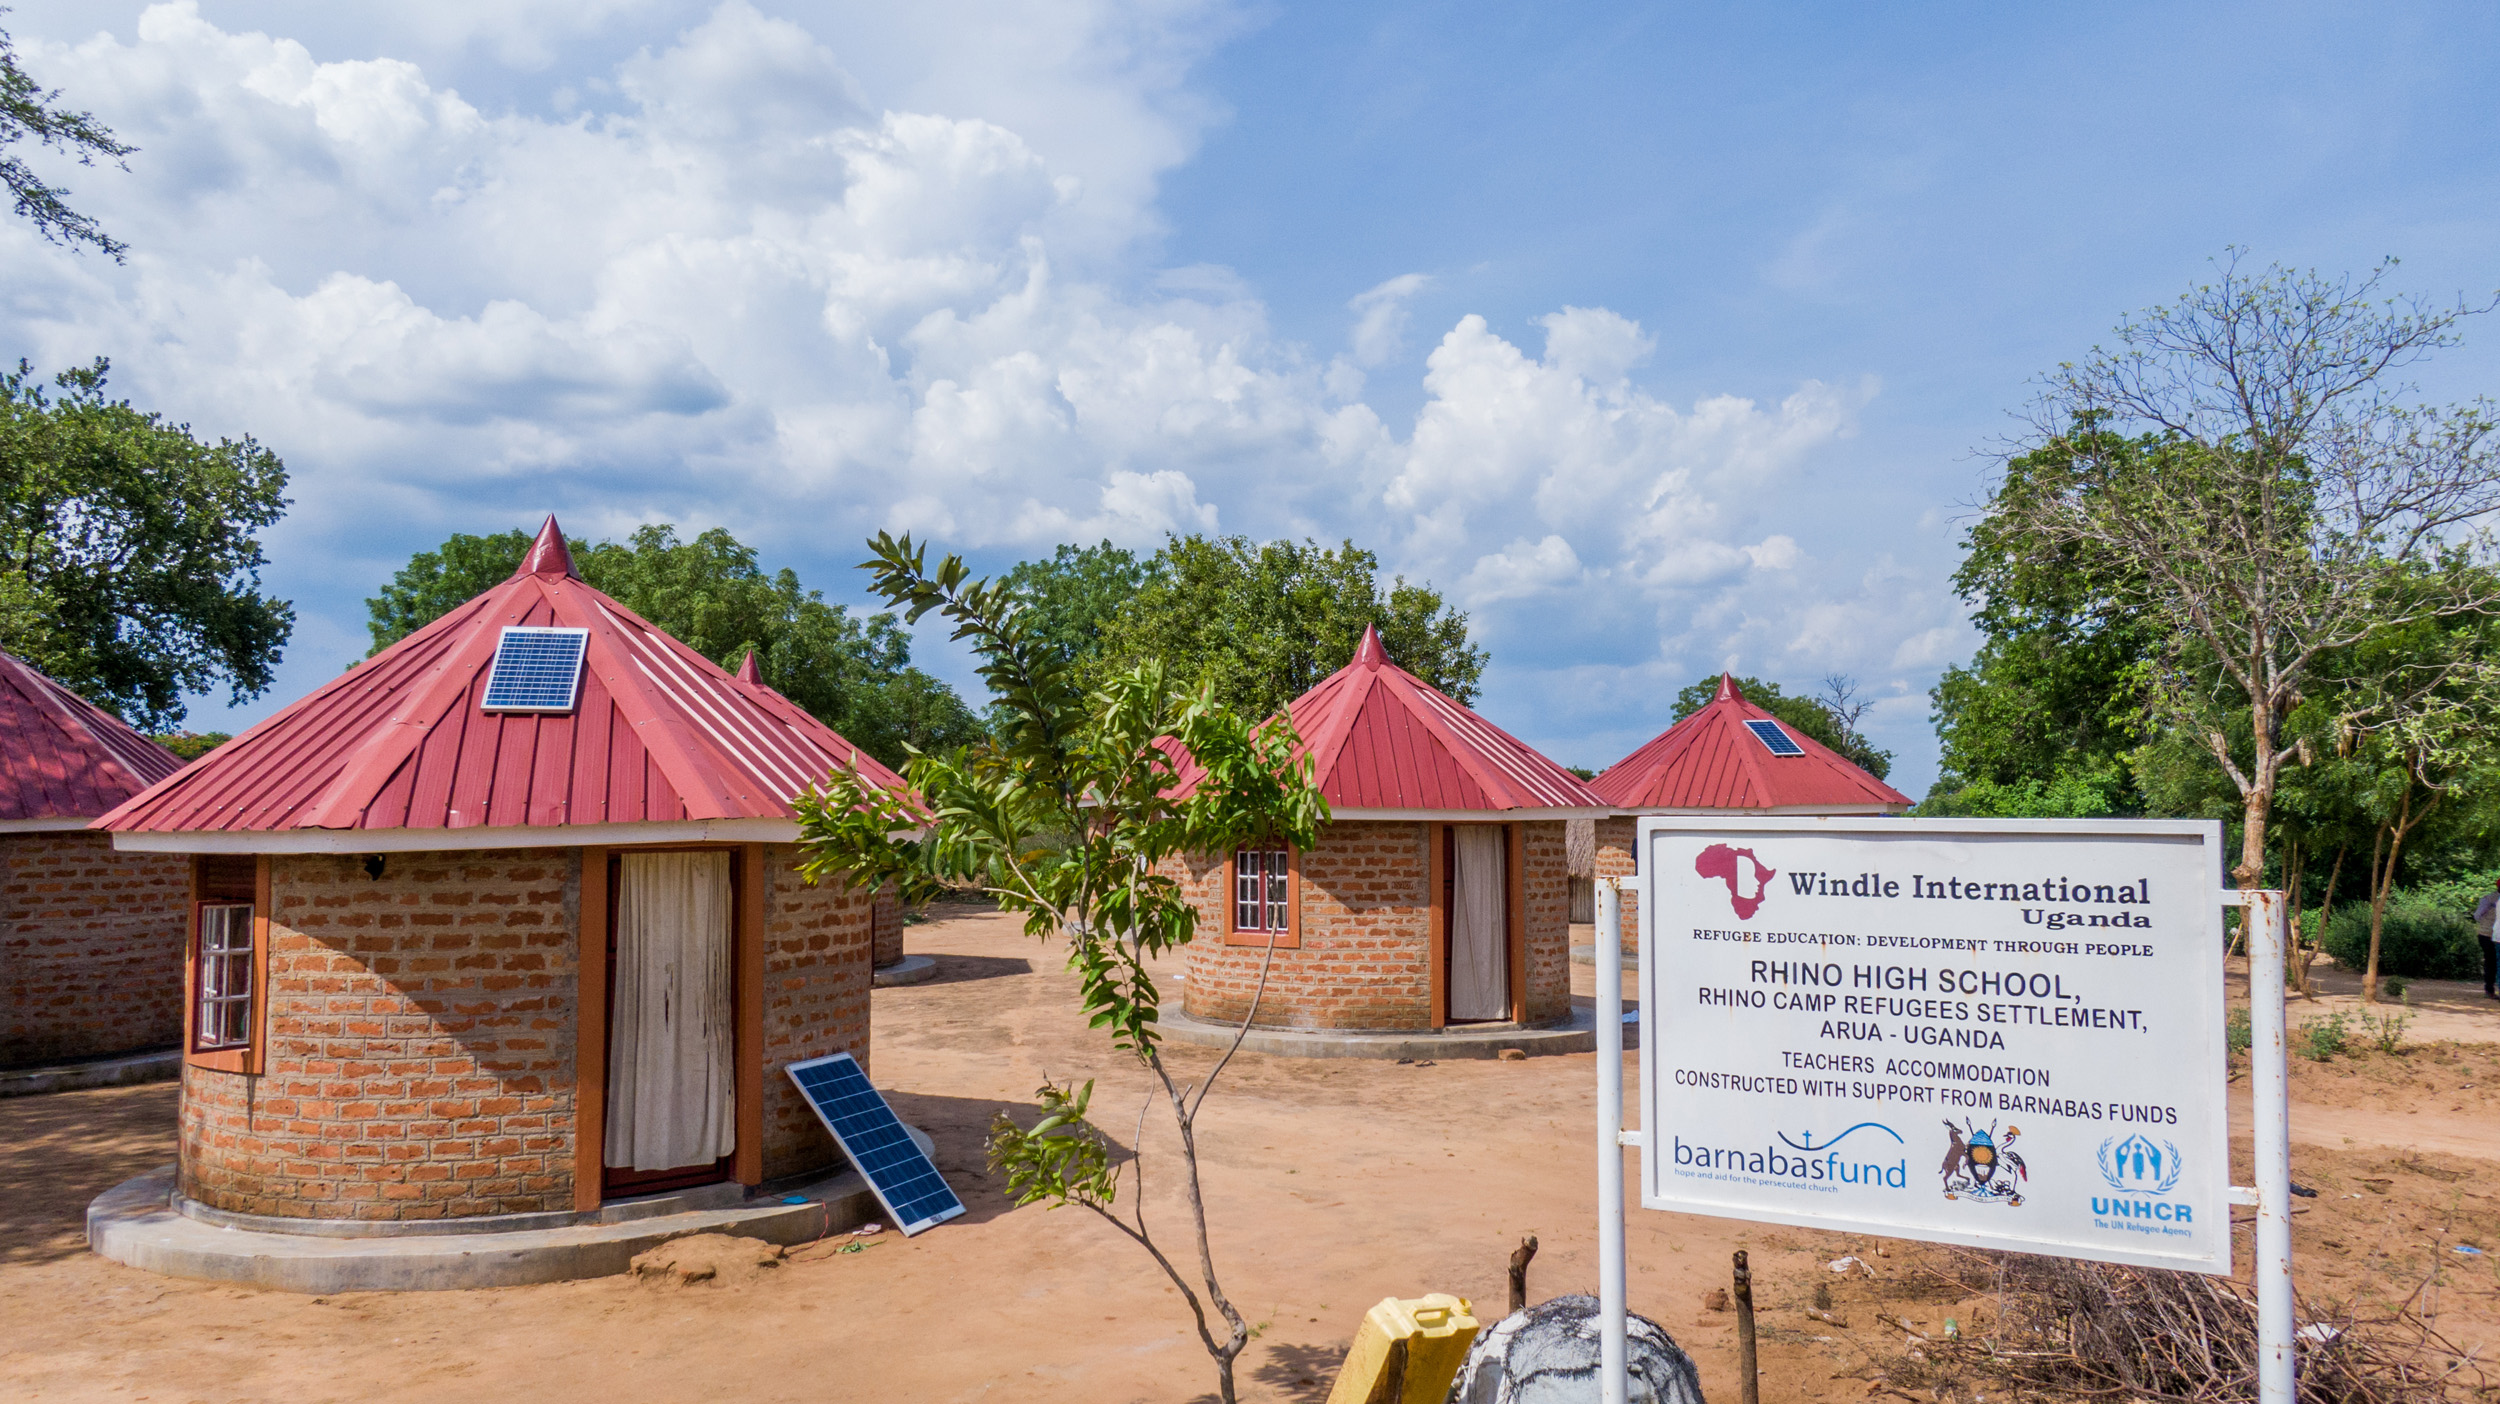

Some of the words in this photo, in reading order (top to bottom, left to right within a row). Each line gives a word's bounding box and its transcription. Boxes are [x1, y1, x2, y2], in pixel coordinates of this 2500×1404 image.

[1788, 872, 1900, 898] Windle
[1913, 874, 2151, 904] International
[2021, 909, 2153, 930] Uganda
[1693, 929, 1761, 943] REFUGEE
[1767, 932, 1861, 946] EDUCATION:
[1867, 936, 1988, 952] DEVELOPMENT
[1993, 941, 2078, 954] THROUGH
[2085, 944, 2154, 957] PEOPLE
[1752, 960, 1843, 987] RHINO
[1854, 965, 1927, 991] HIGH
[1939, 969, 2081, 1006] SCHOOL,
[1699, 986, 1766, 1009] RHINO
[1774, 992, 1837, 1013] CAMP
[1845, 995, 1969, 1021] REFUGEES
[1977, 1003, 2148, 1034] SETTLEMENT,
[1820, 1020, 1883, 1042] ARUA
[1905, 1025, 2006, 1050] UGANDA
[1782, 1051, 1875, 1074] TEACHERS
[1886, 1059, 2050, 1087] ACCOMMODATION
[1676, 1069, 1798, 1095] CONSTRUCTED
[1803, 1080, 1847, 1098] WITH
[1852, 1082, 1935, 1104] SUPPORT
[1941, 1089, 1993, 1109] FROM
[1999, 1094, 2103, 1120] BARNABAS
[2109, 1104, 2178, 1125] FUNDS
[1675, 1136, 1907, 1188] barnabasfund
[1674, 1168, 1695, 1178] hope
[1697, 1171, 1713, 1180] and
[1715, 1172, 1728, 1181] aid
[1729, 1173, 1741, 1183] for
[1743, 1175, 1757, 1184] the
[1759, 1178, 1807, 1190] persecuted
[1808, 1183, 1838, 1193] church
[2091, 1197, 2193, 1222] UNHCR
[2094, 1219, 2109, 1229] The
[2111, 1220, 2124, 1230] UN
[2126, 1222, 2160, 1235] Refugee
[2162, 1225, 2192, 1238] Agency
